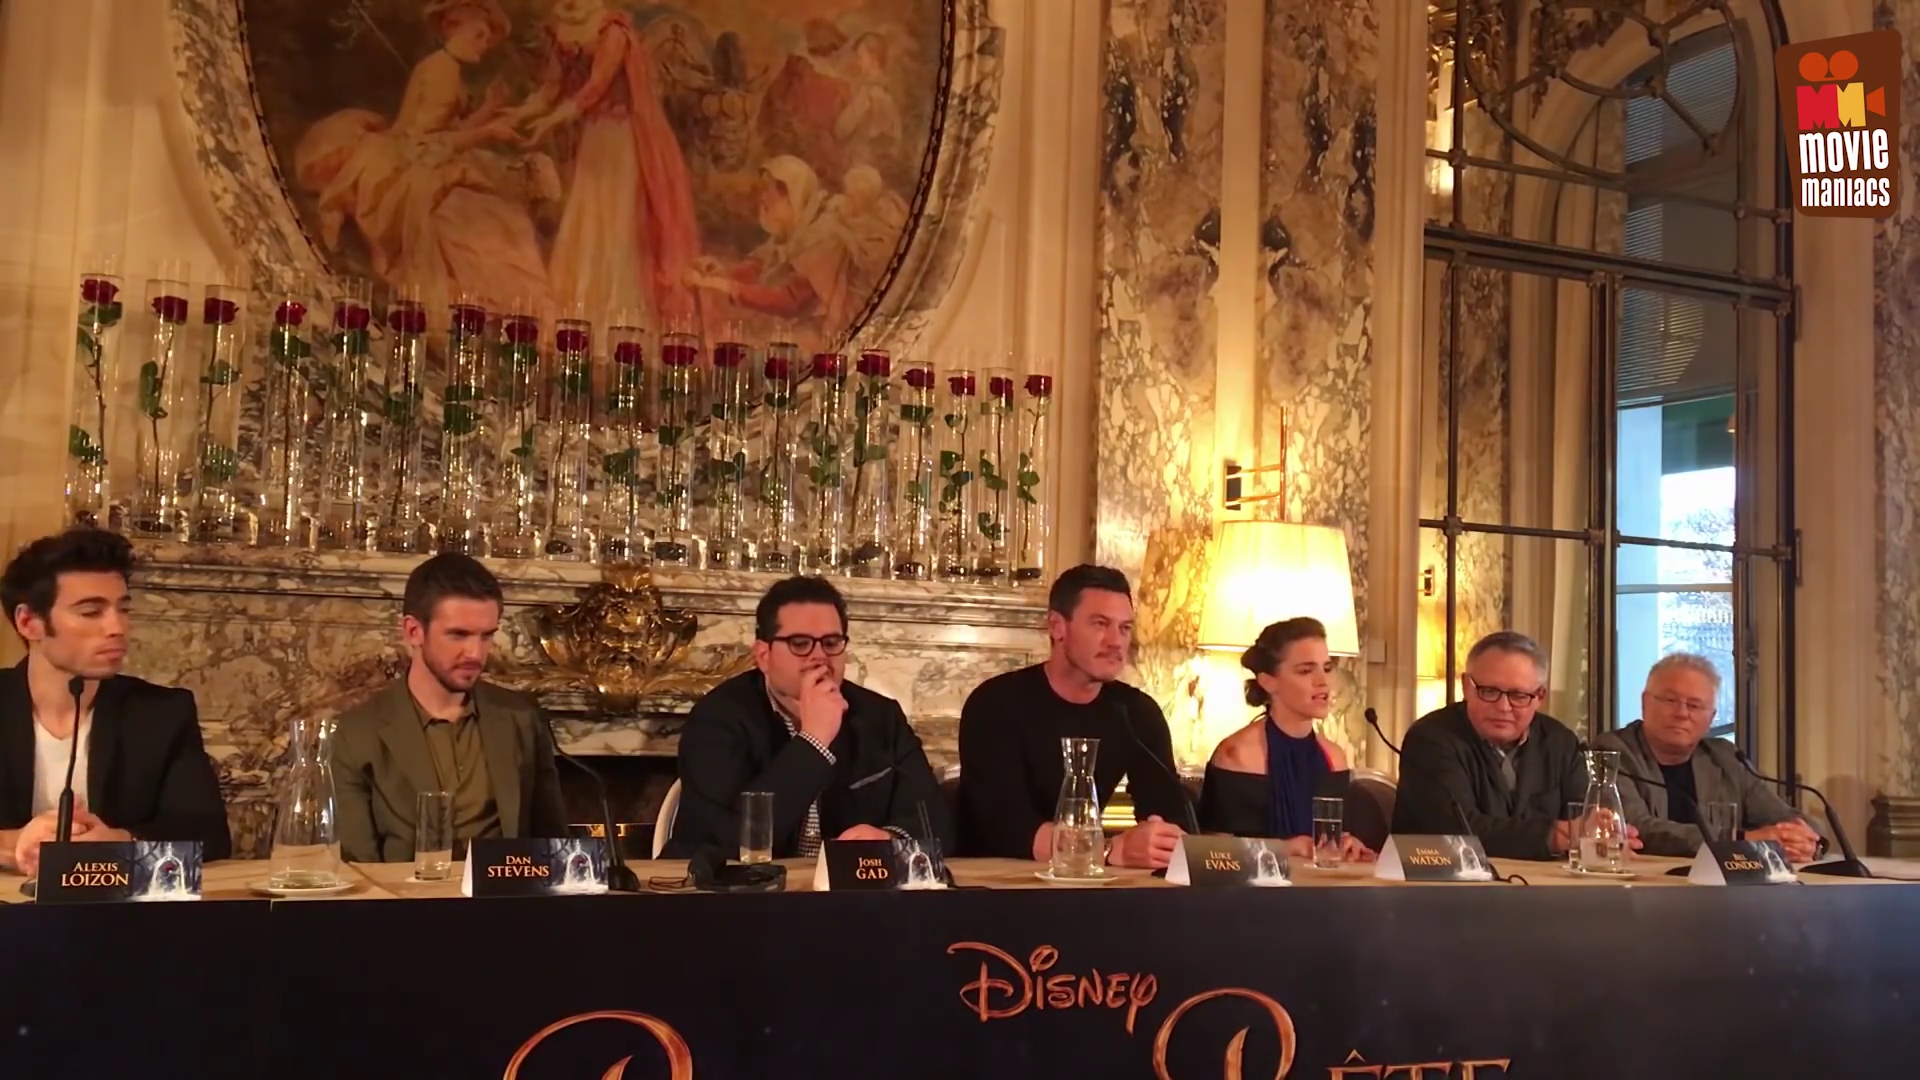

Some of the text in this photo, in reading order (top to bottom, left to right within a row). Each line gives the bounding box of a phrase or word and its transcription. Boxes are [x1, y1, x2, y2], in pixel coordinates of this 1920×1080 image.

[506, 856, 531, 865] DAN
[1210, 851, 1232, 860] LUKE
[1409, 855, 1452, 866] WATSON
[73, 862, 119, 872] ALEXIS
[858, 857, 882, 867] JOSH
[1205, 859, 1241, 872] EVANS
[1725, 860, 1764, 871] CONDON
[487, 865, 549, 878] STEVENS
[856, 868, 888, 880] GAD
[61, 873, 129, 887] LOIZON
